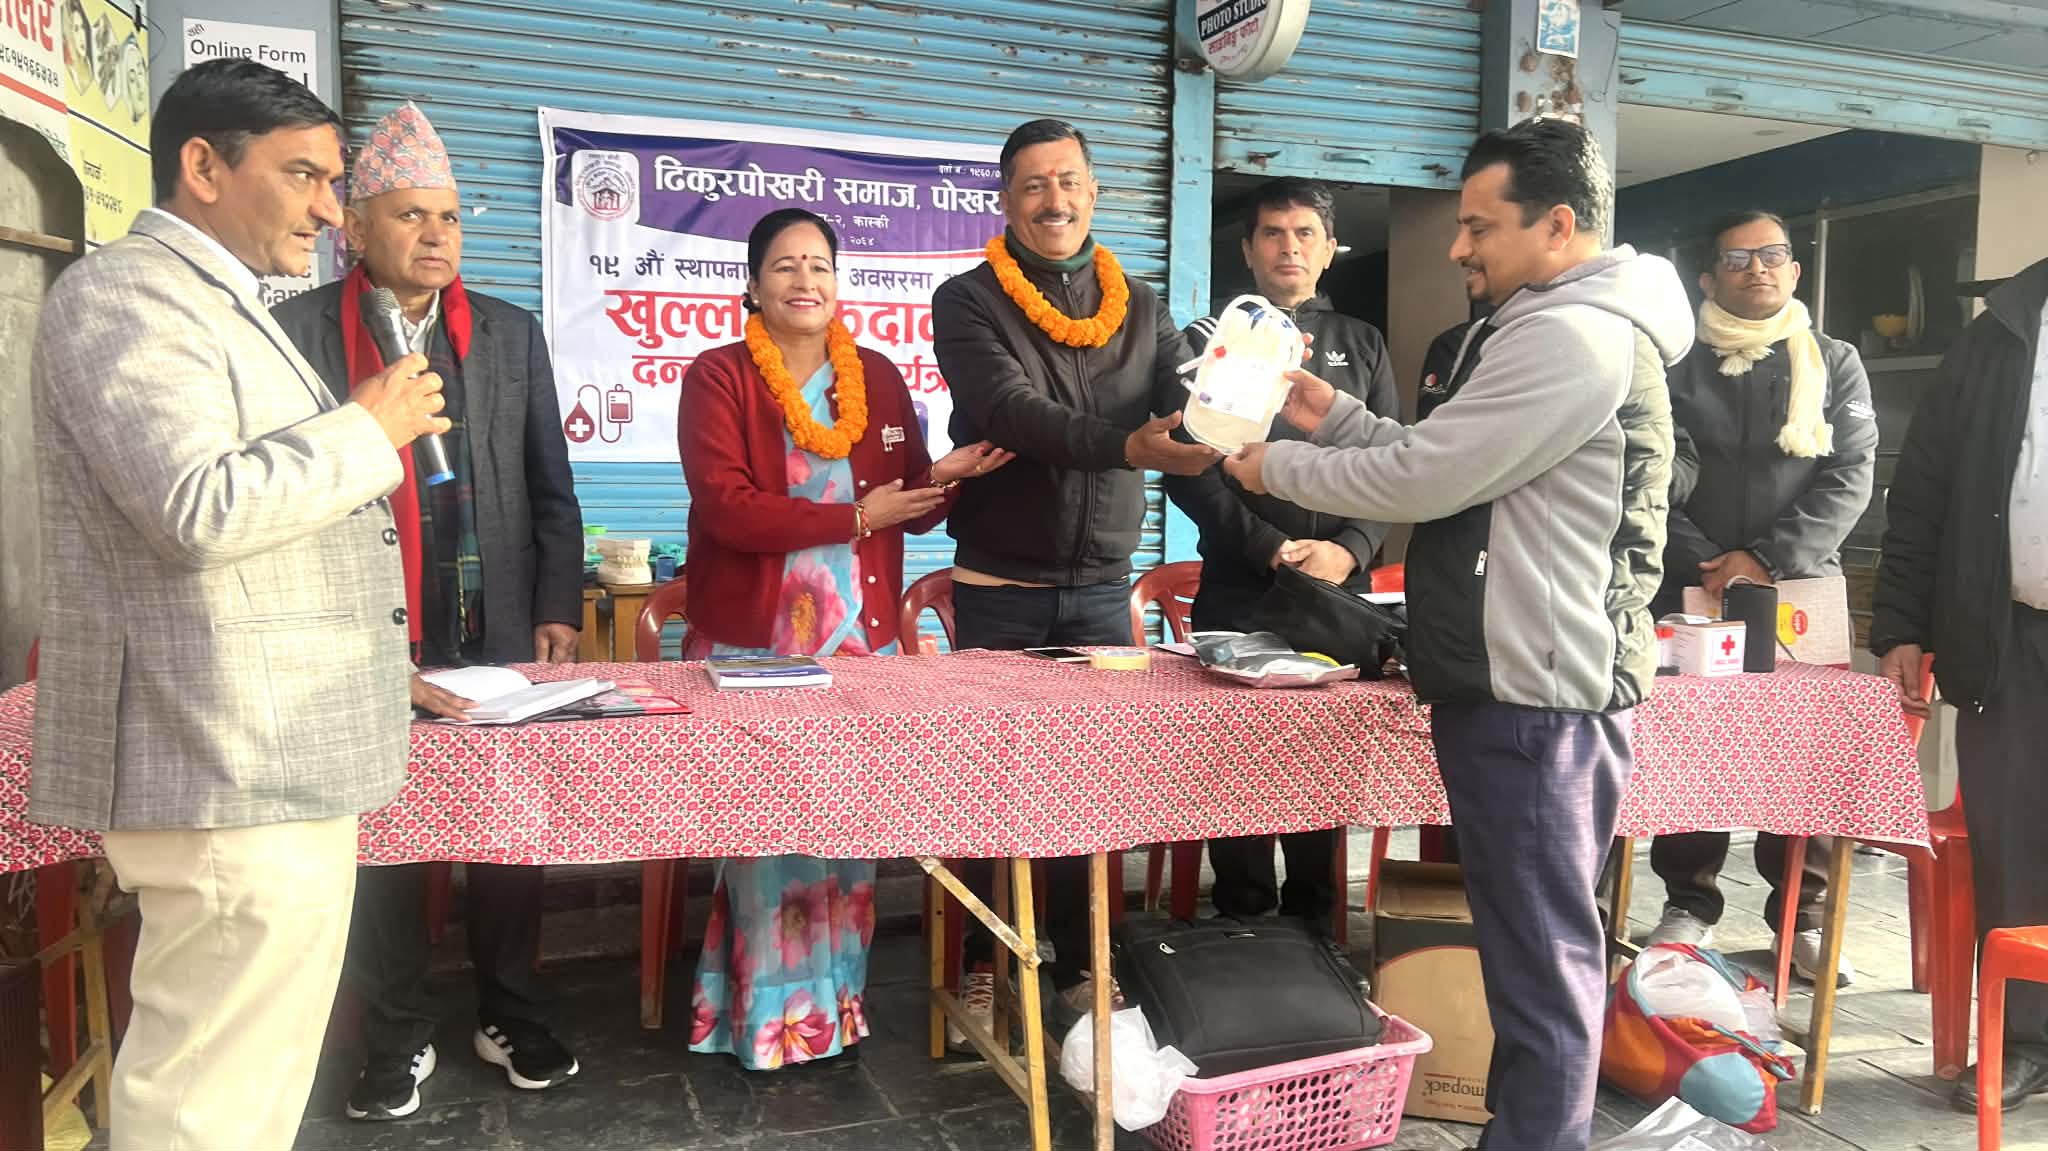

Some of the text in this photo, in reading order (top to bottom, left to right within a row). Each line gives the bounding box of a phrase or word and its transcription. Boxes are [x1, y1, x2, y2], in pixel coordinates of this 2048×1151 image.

[1201, 0, 1265, 37] PHOTO STUD
[190, 39, 306, 63] Online Form
[654, 154, 826, 202] ढिकुरपोखरी
[833, 177, 921, 211] समाज,
[931, 178, 1003, 216] पोखर
[853, 214, 889, 229] कास्की
[850, 236, 875, 246] २०६४
[589, 254, 620, 278] १९
[635, 249, 665, 277] औं
[849, 268, 934, 293] अवसरमा
[604, 289, 746, 349] खुल्ल
[1424, 1077, 1485, 1097] mopack
